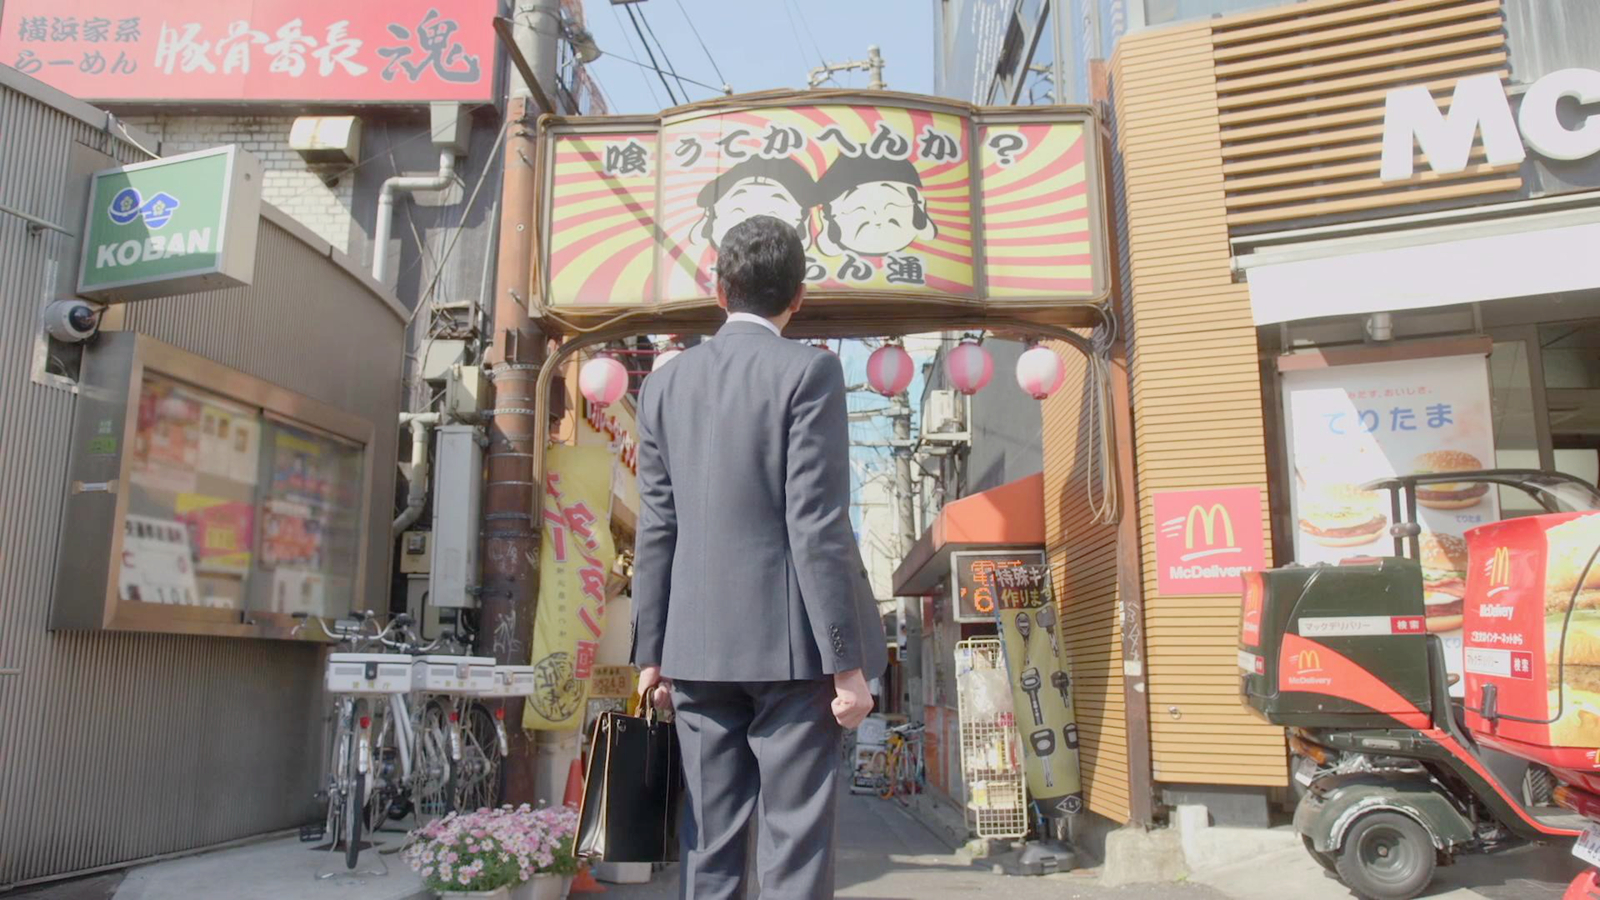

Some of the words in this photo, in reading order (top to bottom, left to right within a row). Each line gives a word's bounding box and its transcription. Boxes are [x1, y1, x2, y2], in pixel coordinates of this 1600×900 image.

[18, 16, 142, 43] 横浜家系
[155, 19, 368, 80] 豚骨番長
[377, 8, 481, 83] 魂
[14, 49, 139, 75] らーめん
[95, 226, 212, 269] KOBAN
[1321, 403, 1454, 435] てりたま
[1396, 619, 1420, 631] 検索
[1513, 657, 1530, 673] 検索
